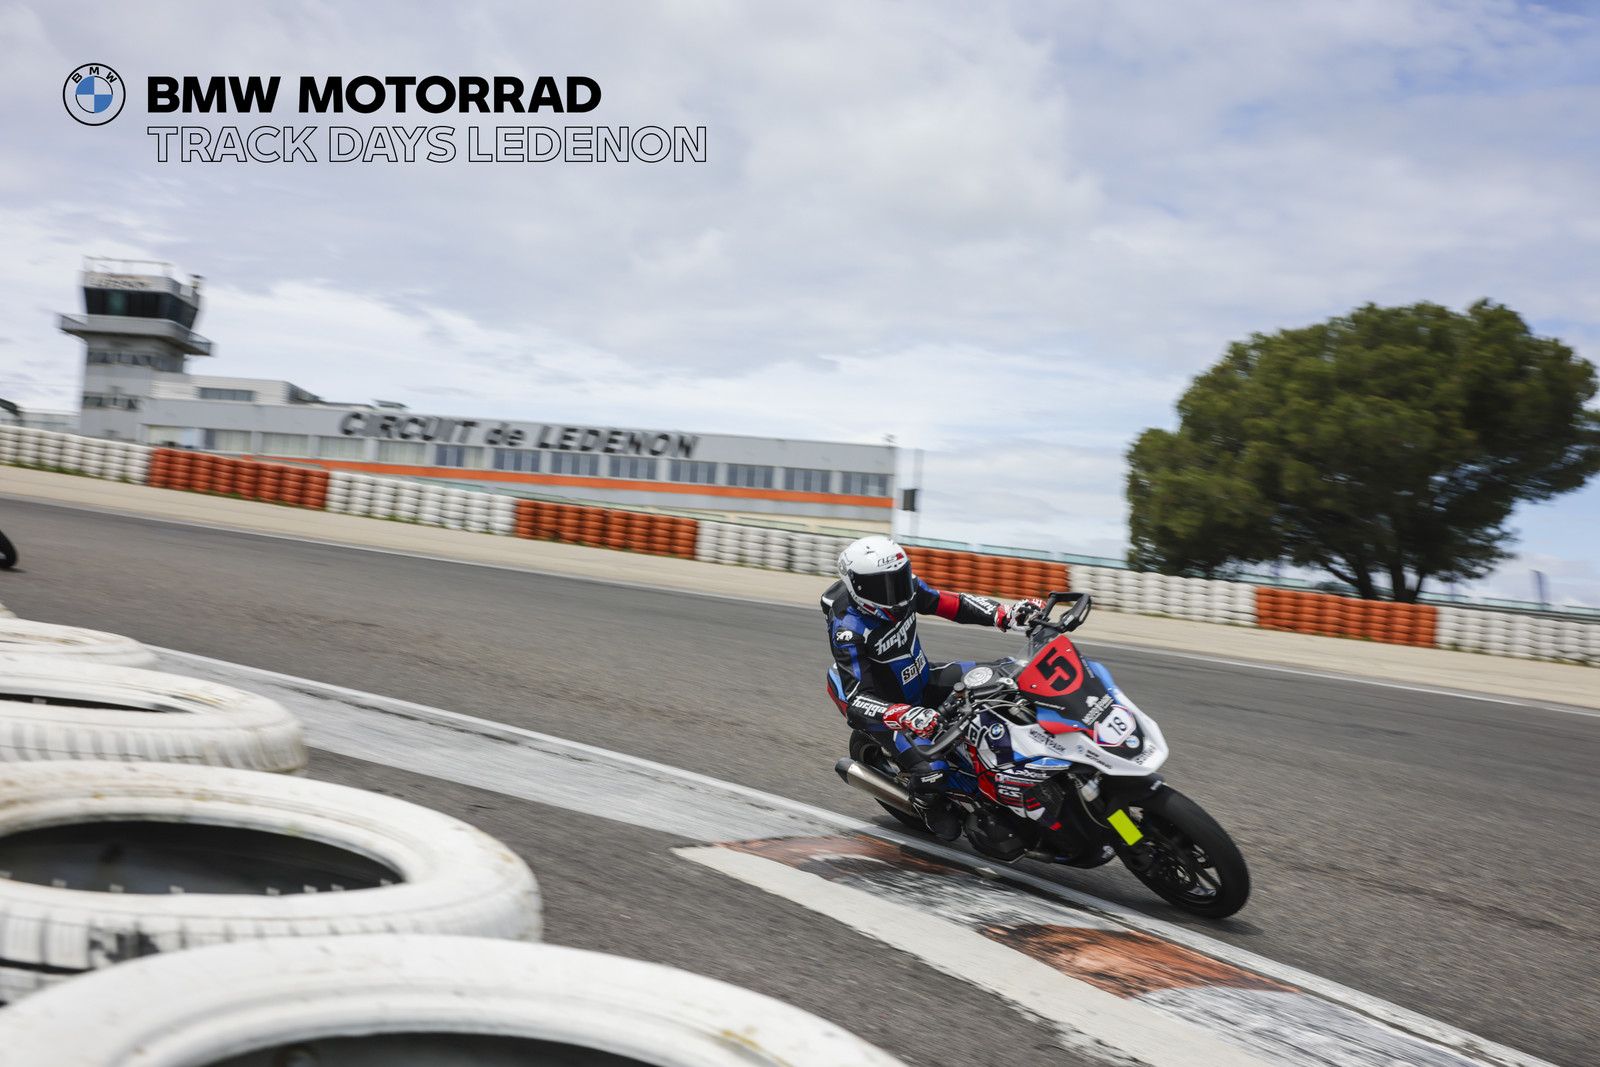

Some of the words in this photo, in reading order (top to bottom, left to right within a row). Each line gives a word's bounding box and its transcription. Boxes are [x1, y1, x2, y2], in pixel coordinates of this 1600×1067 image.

[341, 412, 478, 444] CIRCUIT
[486, 422, 526, 447] de
[537, 425, 700, 458] LEDENON
[1035, 646, 1078, 692] 5
[1107, 716, 1127, 736] 18
